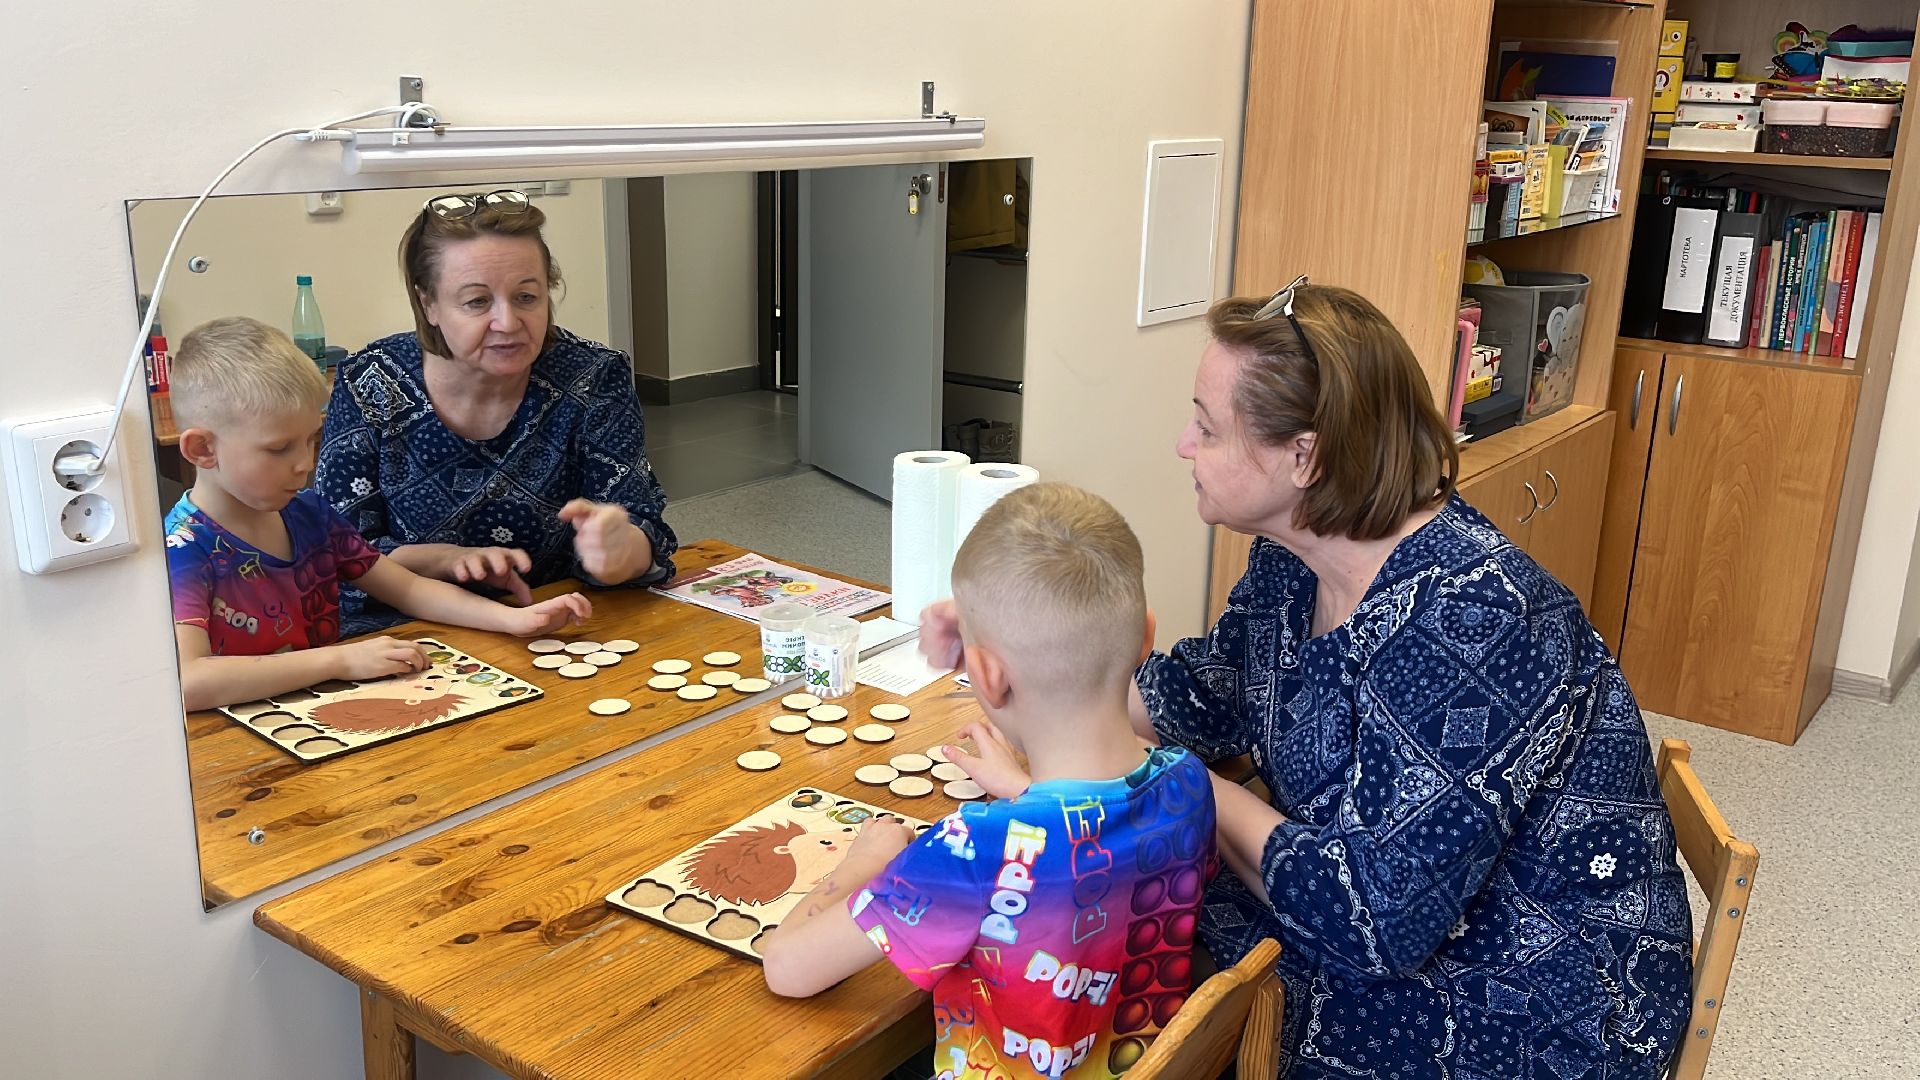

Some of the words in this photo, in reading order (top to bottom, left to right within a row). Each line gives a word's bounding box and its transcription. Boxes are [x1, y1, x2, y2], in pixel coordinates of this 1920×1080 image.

[1680, 236, 1692, 278] КАРТОТЕКА
[1721, 265, 1733, 308] ТЕКУЩАЯ
[1730, 251, 1748, 323] ДОКУМЕНТАЦИЯ
[1779, 286, 1792, 340] ПЕРВОКЛАССНЫЕ
[1787, 256, 1796, 286] ИСТОРИИ
